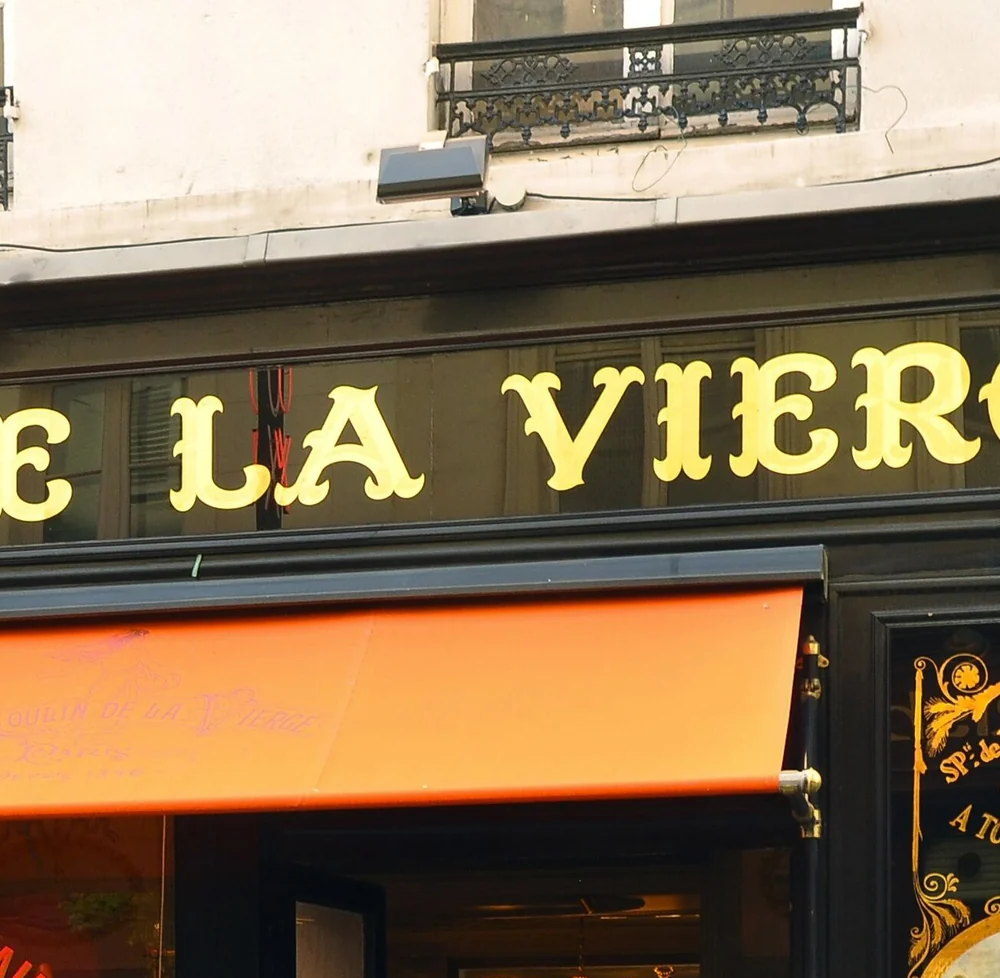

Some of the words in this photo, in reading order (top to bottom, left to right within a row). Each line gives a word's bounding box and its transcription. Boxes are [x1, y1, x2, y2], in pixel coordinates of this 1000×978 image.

[169, 384, 425, 513] LA
[501, 341, 1000, 491] VIER
[948, 804, 973, 833] A
